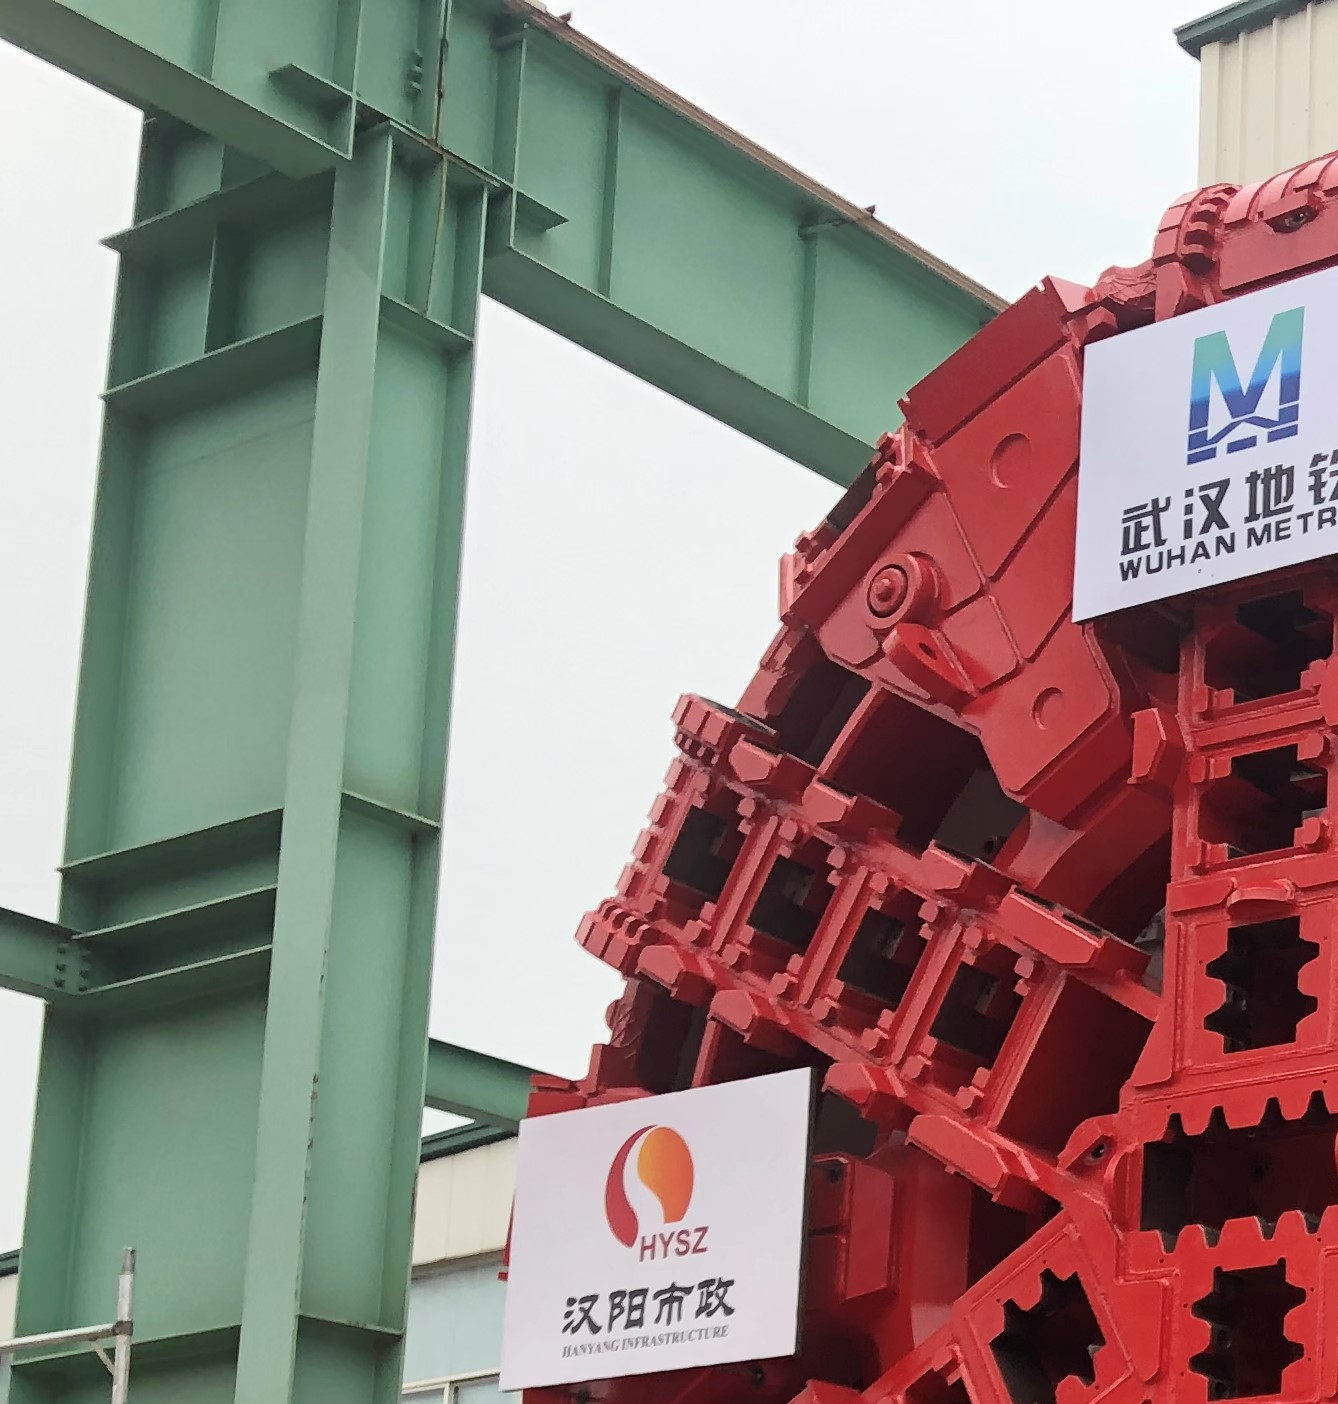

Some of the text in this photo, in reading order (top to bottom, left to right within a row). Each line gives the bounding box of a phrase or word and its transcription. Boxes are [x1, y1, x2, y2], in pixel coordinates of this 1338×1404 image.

[1119, 531, 1236, 581] WUHAN
[639, 1226, 709, 1262] HYSZ
[561, 1276, 735, 1335] 汉阳市政
[562, 1325, 729, 1358] HANYANG INFRASTRUCTURE
